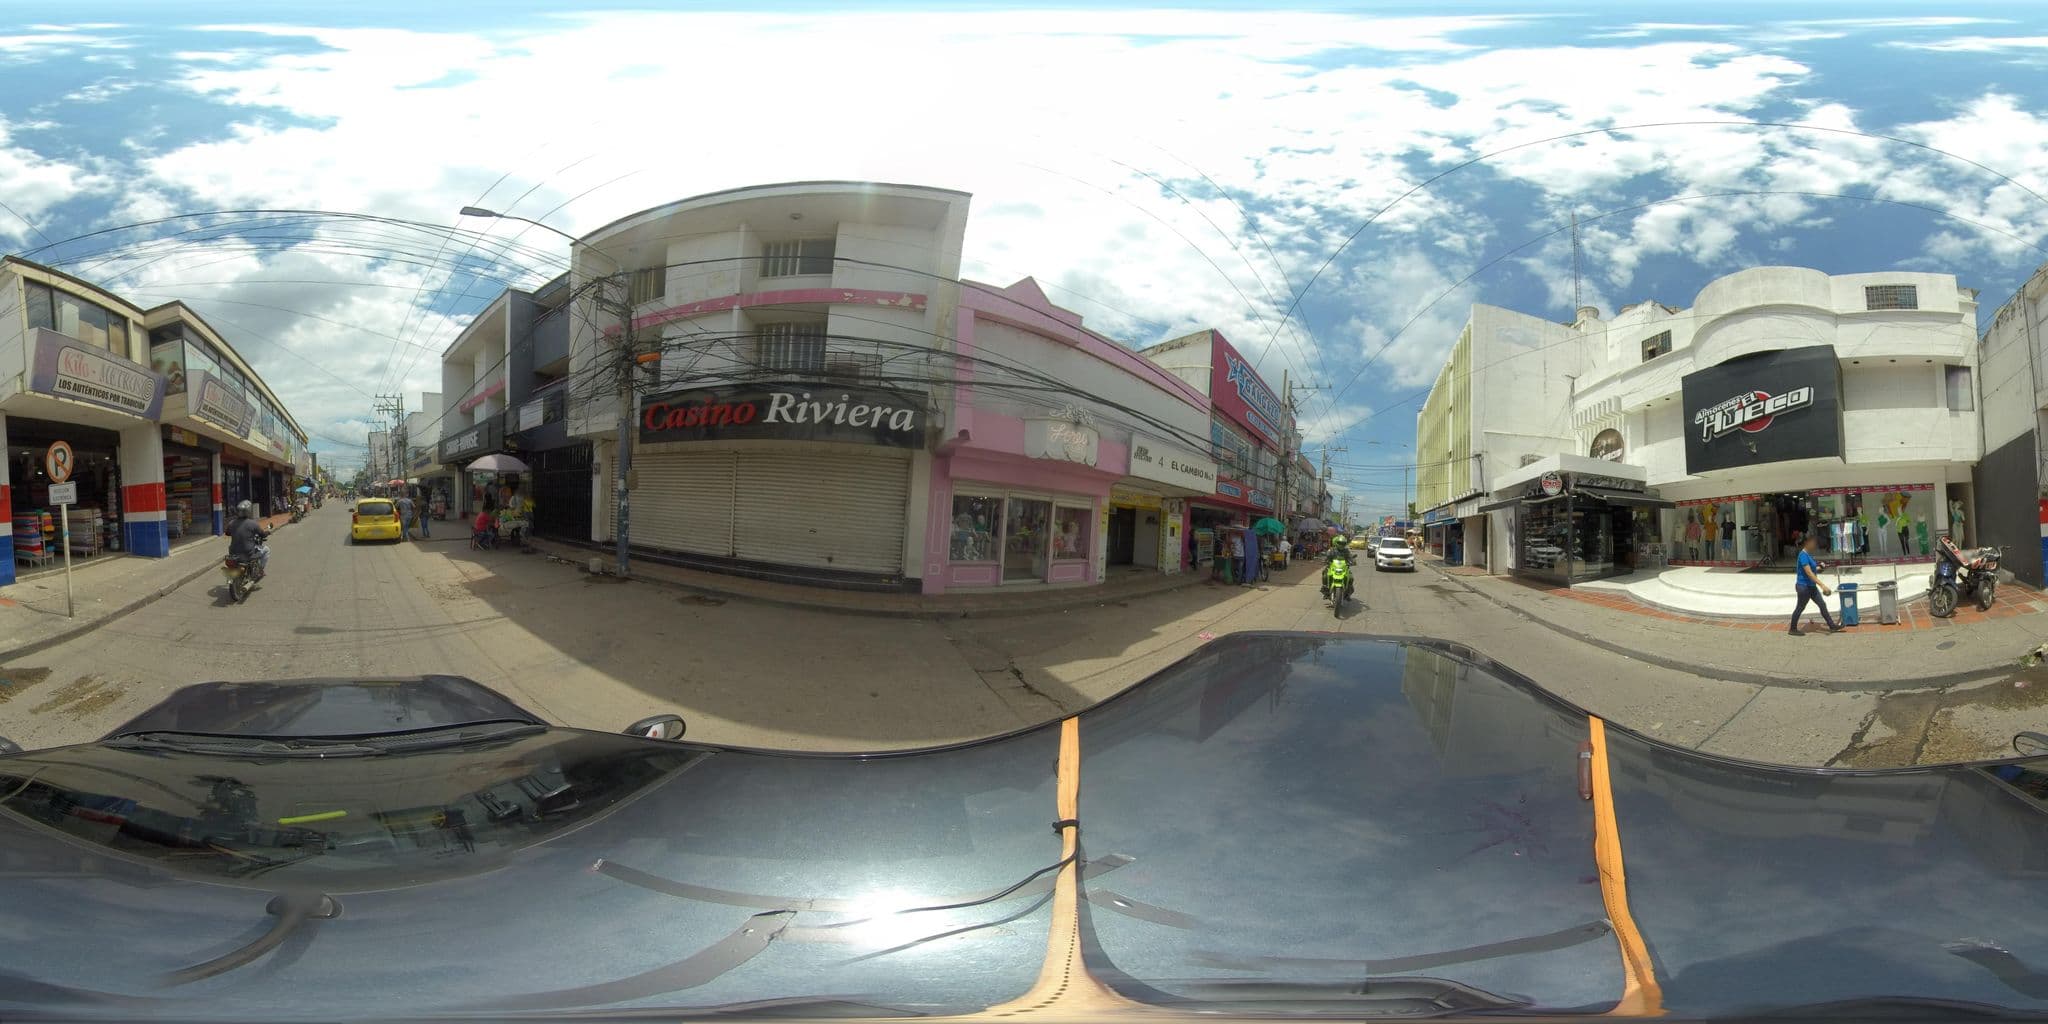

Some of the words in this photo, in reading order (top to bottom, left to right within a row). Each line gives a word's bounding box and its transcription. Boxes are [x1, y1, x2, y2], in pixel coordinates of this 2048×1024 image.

[58, 379, 71, 391] LOS
[72, 381, 110, 400] AUTÉNTICOS
[109, 392, 121, 403] POR
[644, 396, 757, 431] Casino
[763, 392, 915, 432] Riviera
[1695, 395, 1741, 423] Almacenes
[1171, 460, 1179, 471] EL
[1180, 463, 1203, 478] CAMBIO
